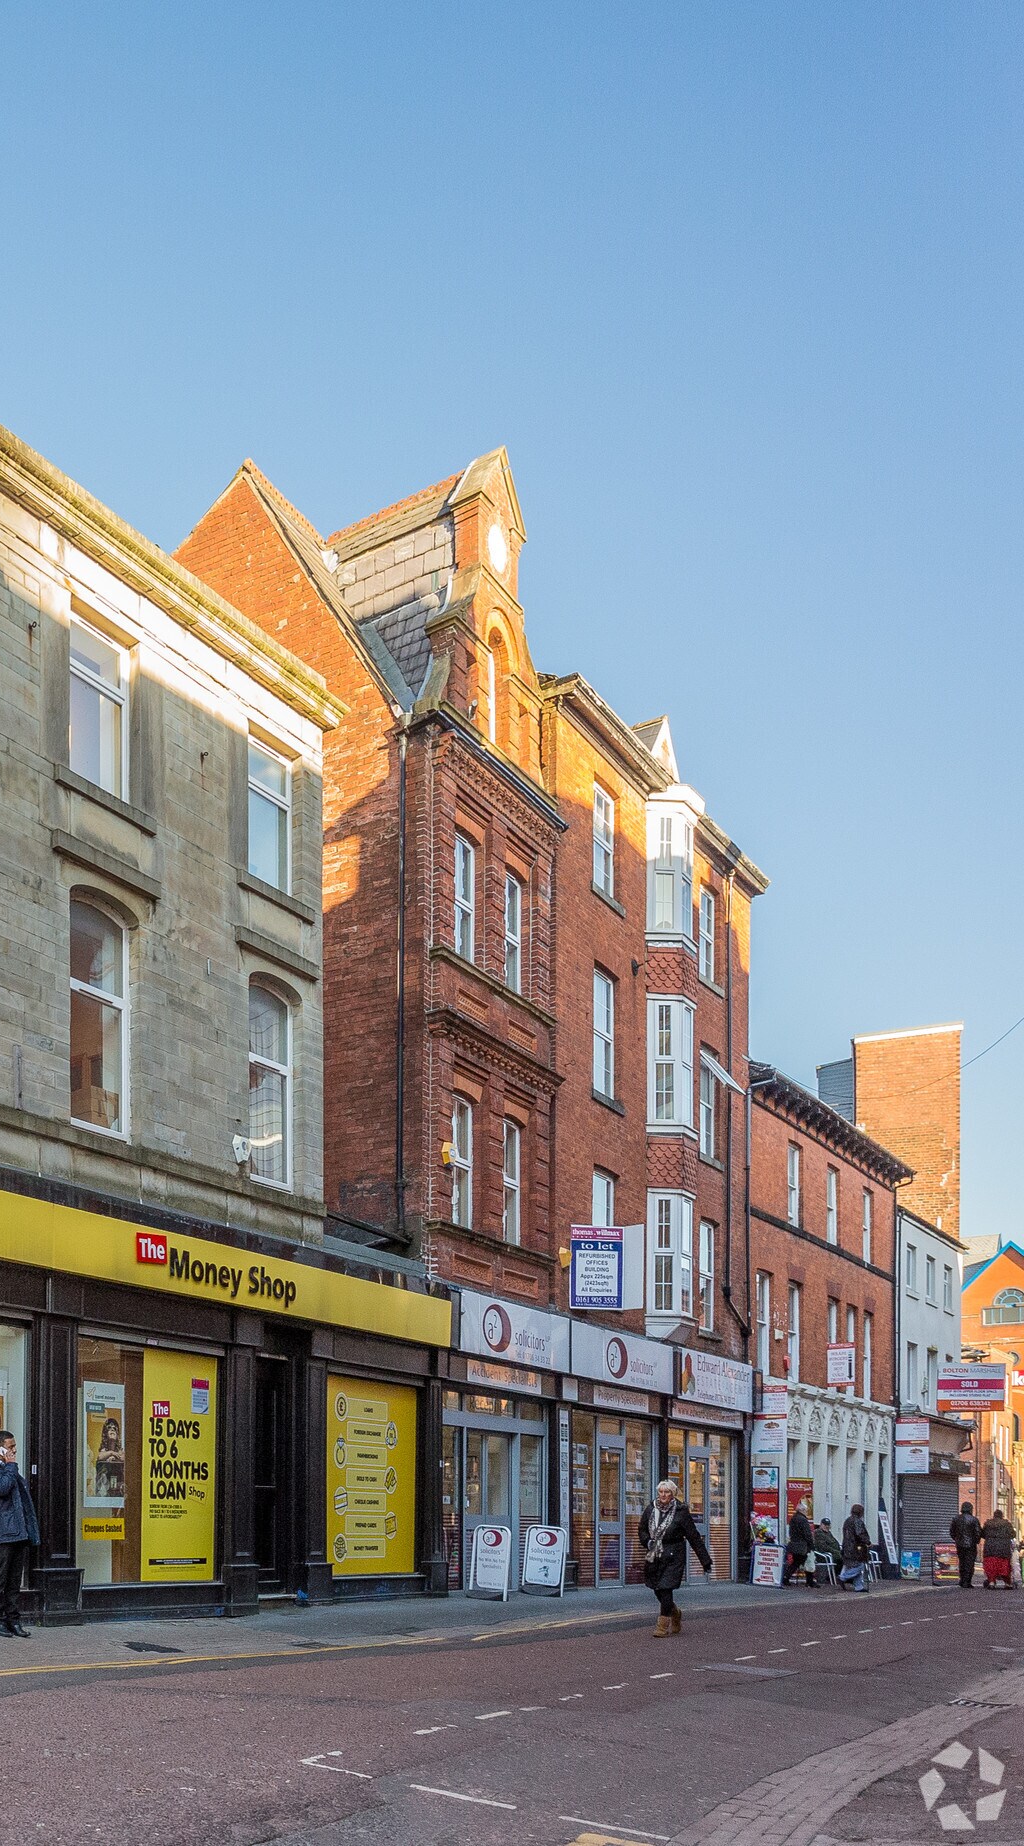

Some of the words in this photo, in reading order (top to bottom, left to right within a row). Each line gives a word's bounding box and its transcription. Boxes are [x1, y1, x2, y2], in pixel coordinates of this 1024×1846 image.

[580, 1242, 594, 1250] to
[598, 1241, 614, 1250] let
[578, 1252, 616, 1260] REFURBISHED
[138, 1237, 166, 1260] The
[169, 1247, 243, 1298] Money
[248, 1265, 297, 1309] Shop
[515, 1329, 546, 1352] solicitors
[471, 1363, 501, 1381] Accident
[504, 1369, 538, 1388] Specialists
[630, 1357, 654, 1377] solicitors
[697, 1354, 721, 1376] Edward
[721, 1359, 751, 1384] Alexander
[960, 1380, 979, 1388] SOLD
[597, 1388, 620, 1406] Property
[153, 1402, 169, 1416] The
[149, 1416, 164, 1437] 15
[166, 1418, 201, 1440] DAYS
[148, 1438, 167, 1458] TO
[170, 1439, 178, 1459] 6
[149, 1458, 209, 1481] MONTHS
[149, 1479, 186, 1500] LOAN
[188, 1486, 206, 1501] Shop
[84, 1524, 105, 1534] Cheques
[105, 1523, 122, 1533] Cashed
[480, 1548, 501, 1556] solicitors
[531, 1548, 556, 1556] solicitors
